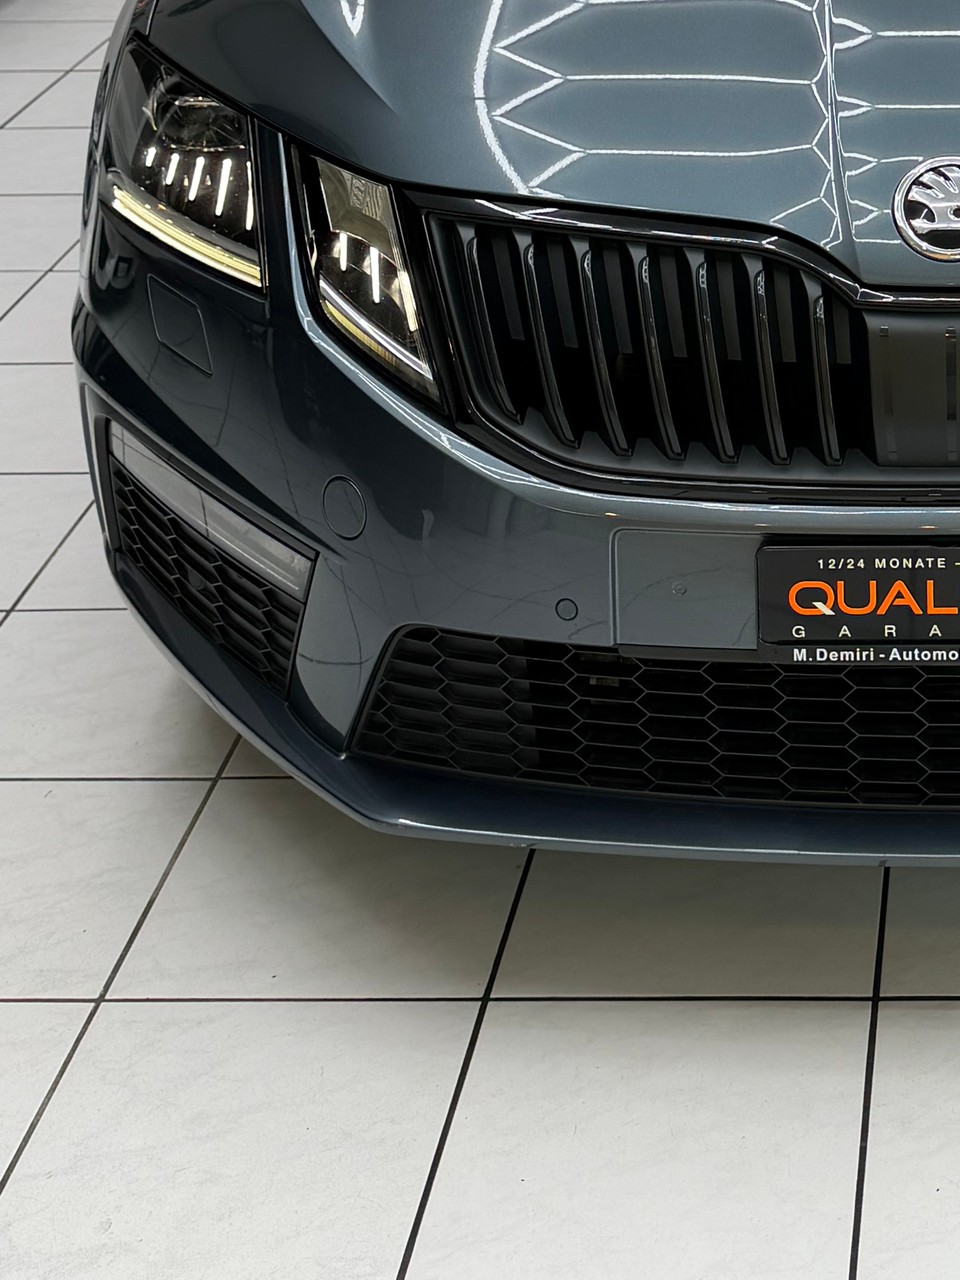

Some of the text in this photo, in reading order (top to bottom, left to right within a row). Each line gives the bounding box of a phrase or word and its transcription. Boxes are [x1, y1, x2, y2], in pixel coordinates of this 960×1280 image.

[817, 558, 865, 569] 12/24
[874, 558, 946, 569] MONATE
[793, 648, 874, 661] M.Demiri
